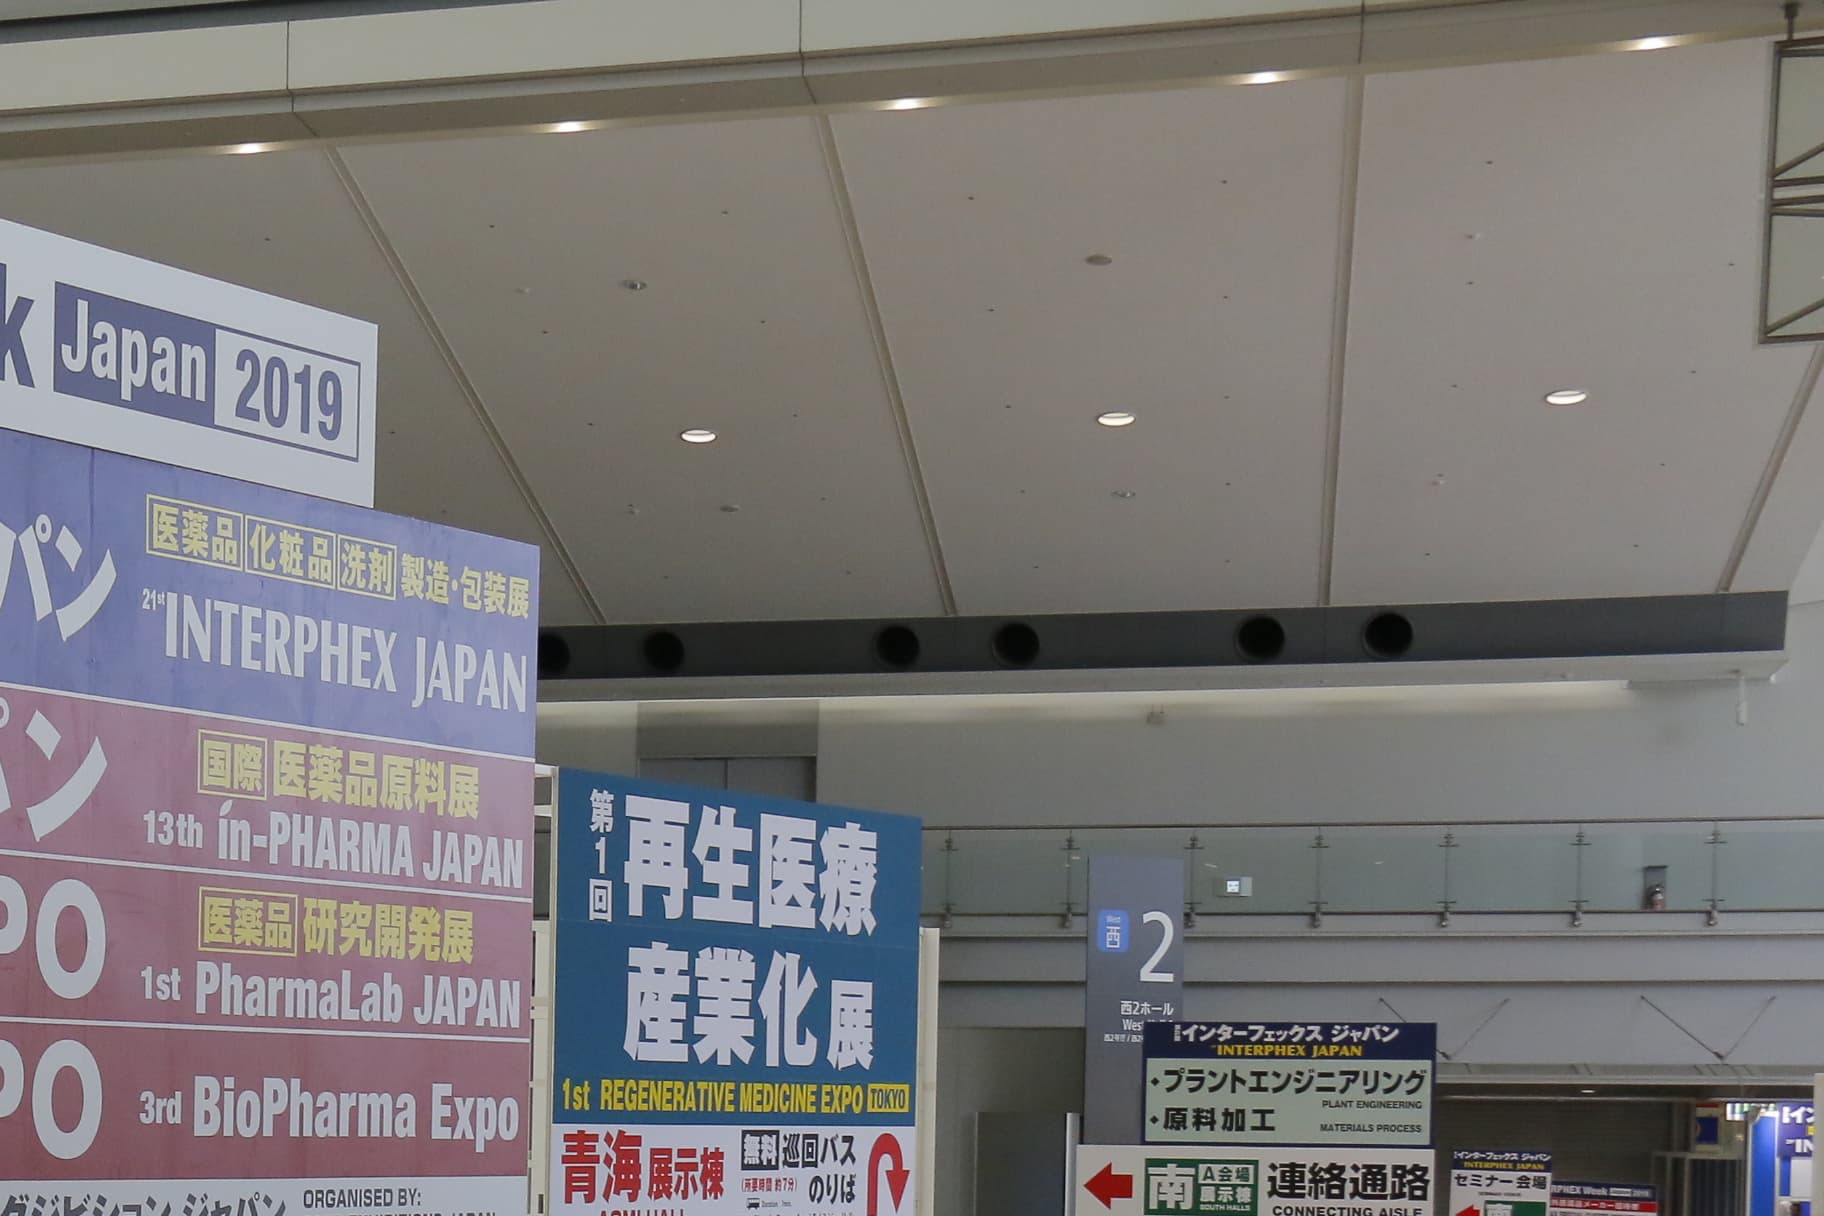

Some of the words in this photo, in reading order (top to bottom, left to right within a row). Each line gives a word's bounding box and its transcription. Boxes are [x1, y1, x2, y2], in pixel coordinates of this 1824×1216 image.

[60, 299, 208, 402] Japan
[235, 348, 344, 442] 2019
[151, 503, 238, 565] 医薬品
[248, 523, 335, 582] 化粧品
[164, 592, 398, 693] INTERPHEX
[412, 636, 528, 713] JAPAN
[203, 736, 264, 792] 国際
[143, 810, 203, 848] 13th
[422, 830, 524, 889] JAPAN
[623, 793, 878, 936] 再生医療
[204, 896, 293, 949] 医薬品
[303, 897, 474, 964] 研究開発展
[1139, 910, 1175, 983] 2
[140, 966, 182, 1001] 1st
[196, 960, 403, 1023] PharmaLab
[413, 974, 521, 1028] JAPAN
[1182, 1024, 1323, 1043] インターフェックス
[1330, 1024, 1400, 1043] ジャパン
[1216, 1044, 1306, 1056] INTERPHEX
[1311, 1044, 1363, 1057] JAPAN
[561, 1077, 590, 1110] 1st
[599, 1077, 736, 1112] REGENERATIVE
[739, 1082, 817, 1113] MEDICINE
[821, 1083, 863, 1114] EXPO
[870, 1087, 906, 1110] TOKYO
[1163, 1067, 1427, 1096] プラントエンジニアリング
[139, 1090, 182, 1125] 3rd
[193, 1075, 416, 1138] BioPharma
[430, 1082, 519, 1153] Expo
[1162, 1106, 1276, 1133] 原料加工
[1321, 1100, 1353, 1109] PLANT
[1356, 1100, 1423, 1109] ENGINEERING
[1320, 1123, 1374, 1133] MATERIALS
[1376, 1123, 1422, 1133] PROCESS
[782, 1132, 856, 1168] 巡回バス
[303, 1187, 394, 1210] ORGANISED
[398, 1188, 422, 1208] BY:
[809, 1173, 857, 1204] のりば
[1147, 1162, 1196, 1210] 南
[1267, 1162, 1431, 1201] 連絡通路
